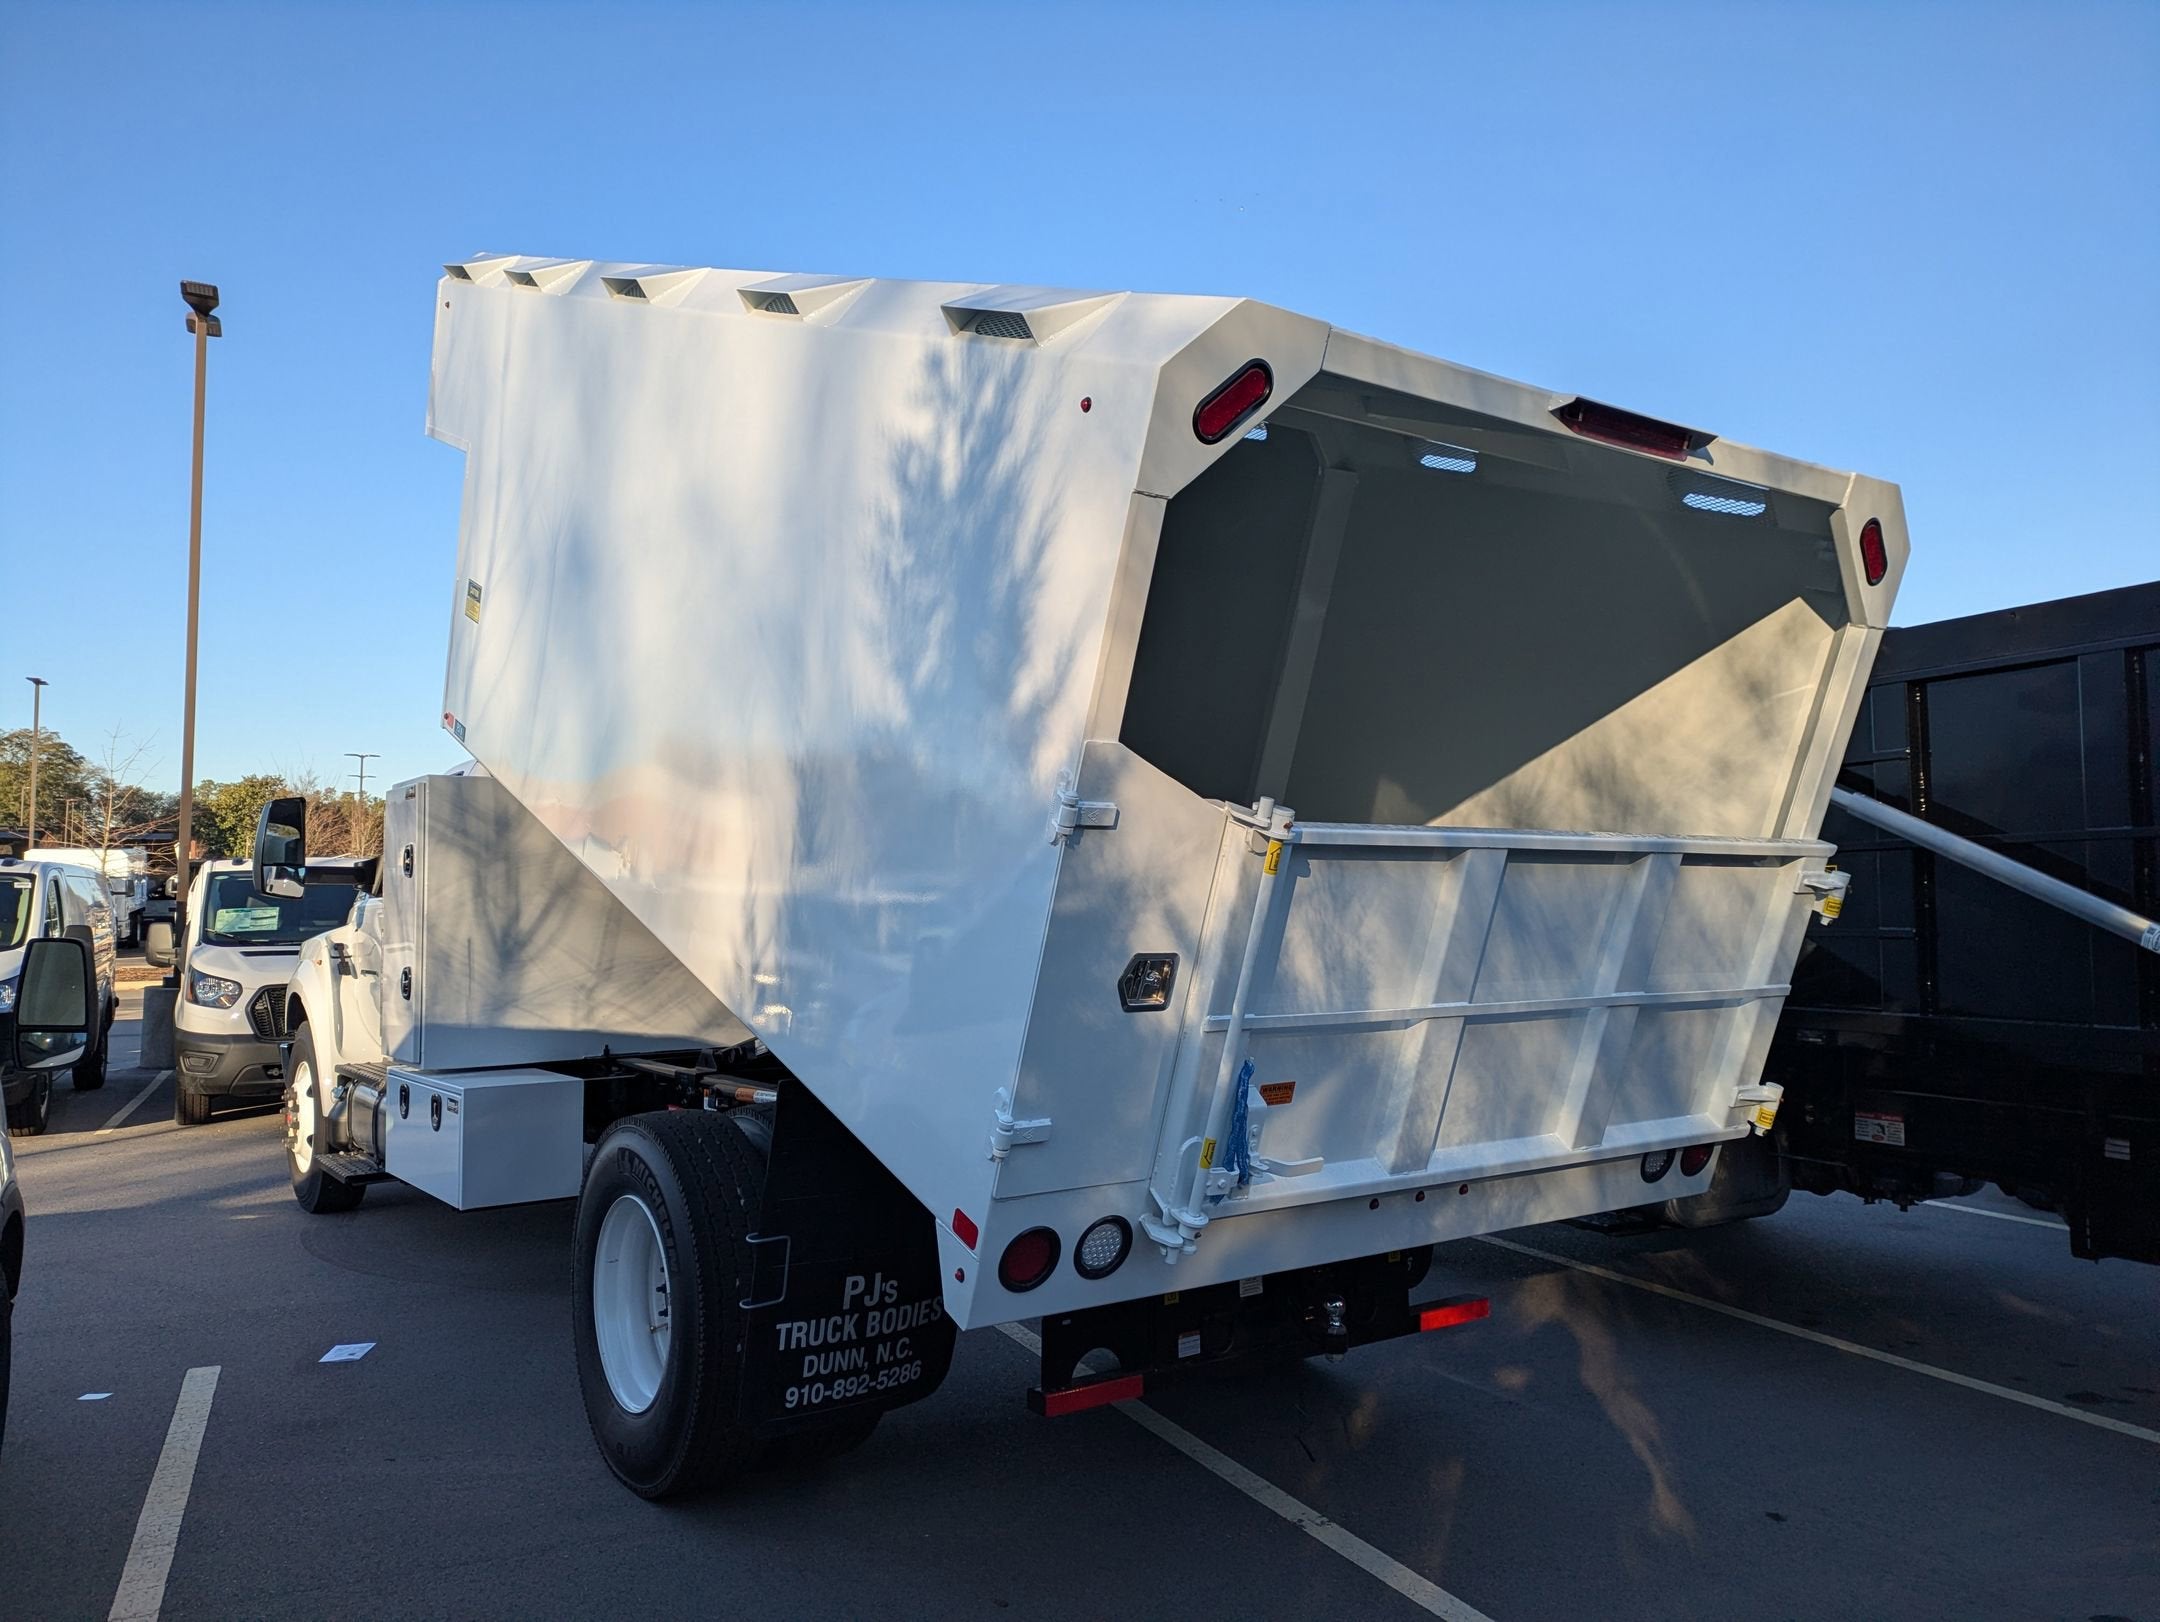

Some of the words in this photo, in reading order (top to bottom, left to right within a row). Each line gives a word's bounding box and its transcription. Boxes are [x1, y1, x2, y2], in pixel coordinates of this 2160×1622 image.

[775, 1312, 860, 1351] TRUCK
[865, 1295, 944, 1339] BODIES
[802, 1346, 869, 1378] DUNN,
[875, 1336, 913, 1365] N.C.
[784, 1360, 922, 1409] 910-892-5286
